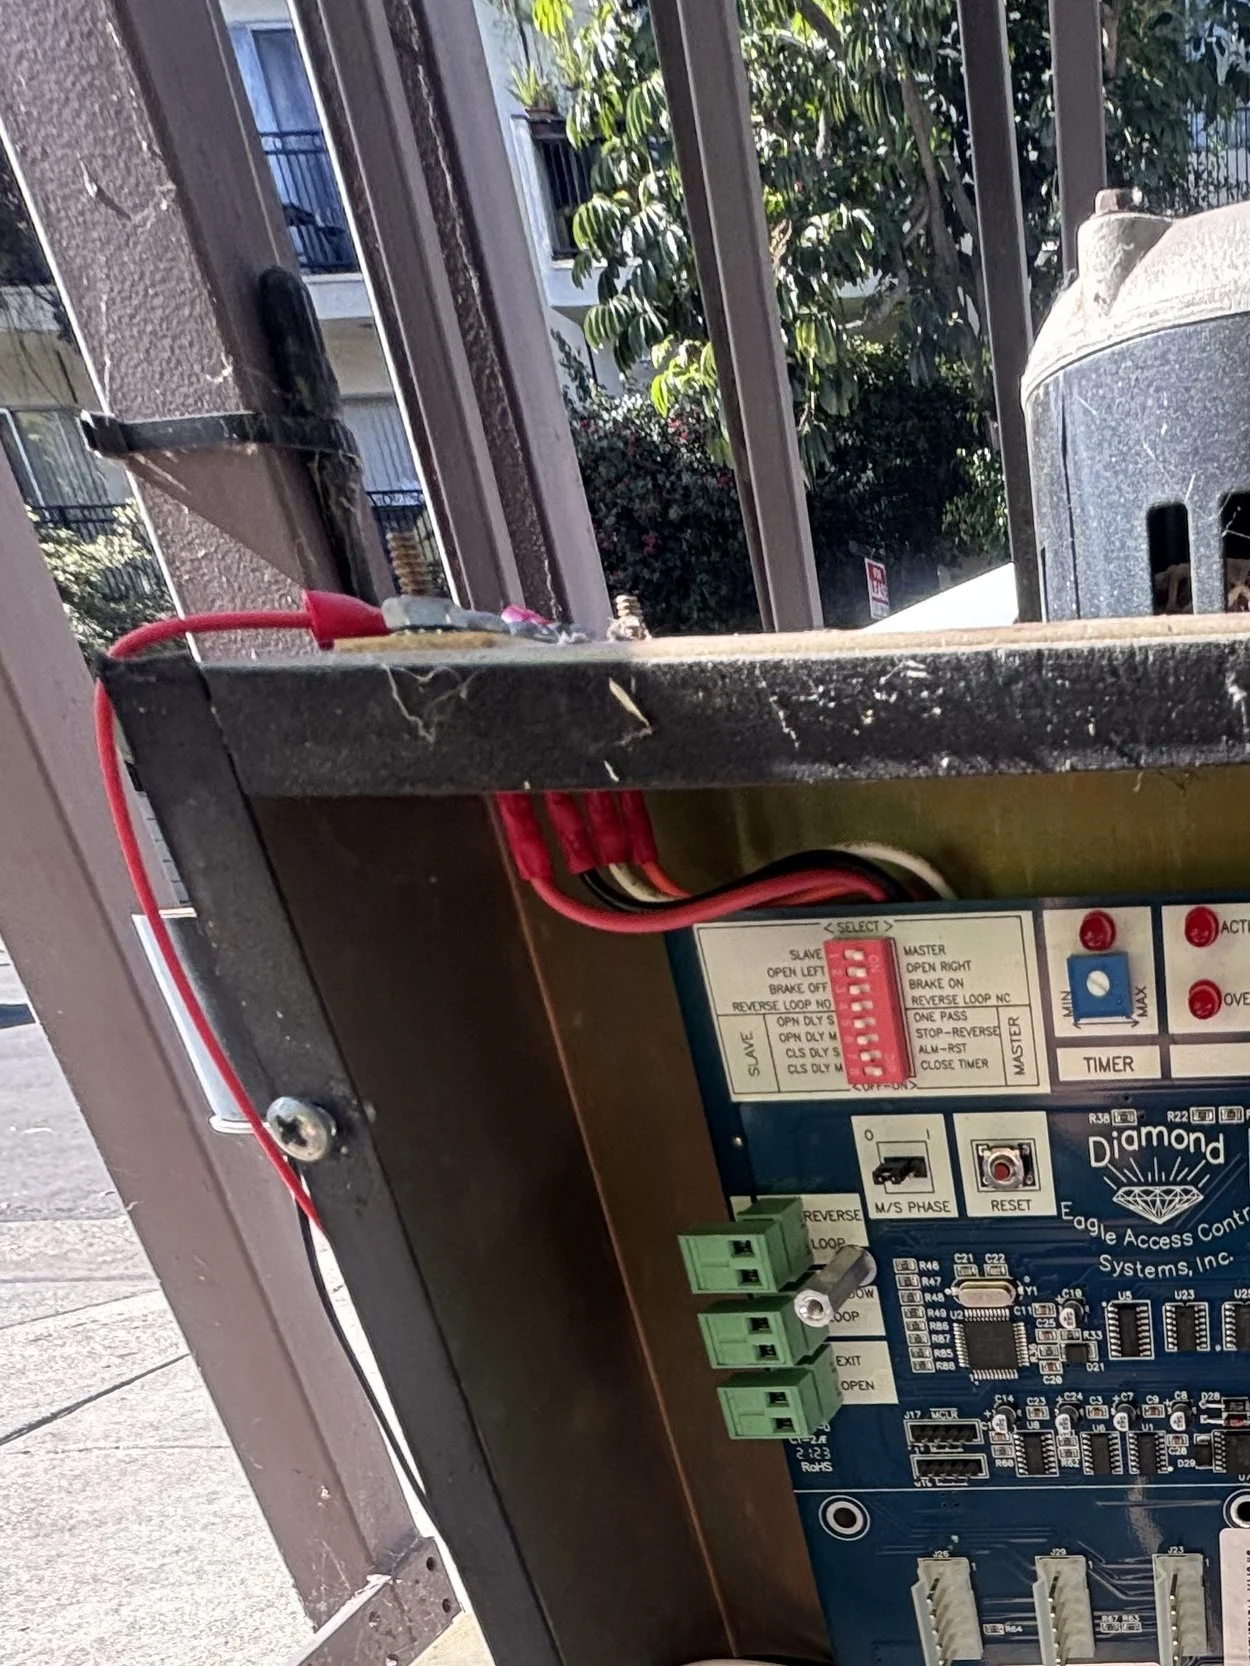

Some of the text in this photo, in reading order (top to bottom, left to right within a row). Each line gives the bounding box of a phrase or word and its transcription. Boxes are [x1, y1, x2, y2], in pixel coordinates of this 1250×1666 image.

[789, 949, 823, 960] SLAVE
[903, 945, 945, 956] MASTER
[767, 966, 825, 978] OPEN LEFT
[906, 960, 972, 973] OPEN RIGHT
[769, 982, 828, 994] BRAKE OFF
[909, 978, 964, 989] BRAKE ON
[732, 999, 832, 1012] REVERSE LOOP NO
[911, 993, 1011, 1006] REVERSE LOOP NC
[1062, 991, 1072, 1017] MIN
[1136, 987, 1147, 1016] MAX
[777, 1015, 835, 1026] OPN DLY S
[914, 1011, 968, 1022] ONE PASS
[779, 1032, 801, 1042] OPN
[805, 1032, 827, 1042] DLY
[915, 1026, 1000, 1038] STOP-REVERSE
[918, 1043, 967, 1054] ALM-RST
[1008, 1016, 1025, 1076] MASTER
[741, 1032, 760, 1077] SLAVE
[786, 1047, 840, 1059] CLS DLY S
[787, 1064, 808, 1074] CLS
[811, 1063, 833, 1073] DLY
[920, 1058, 989, 1071] CLOSE TIMER
[1083, 1056, 1135, 1073] TIMER
[1167, 1111, 1188, 1122] R22
[1089, 1125, 1224, 1168] Diamond
[876, 1201, 951, 1214] M/S PHASE
[991, 1199, 1032, 1212] RESET
[803, 1210, 862, 1222] REVERSE
[1061, 1202, 1117, 1245] Eagle
[1124, 1230, 1193, 1249] Access
[811, 1238, 845, 1250] LOOP
[1099, 1251, 1234, 1278] Systems, Inc.
[922, 1277, 941, 1287] R47
[1175, 1290, 1194, 1299] U23
[830, 1312, 859, 1323] OOP
[927, 1308, 947, 1318] R49
[836, 1356, 861, 1366] EXIT
[841, 1381, 874, 1390] OPEN
[995, 1395, 1014, 1403] C14
[1027, 1397, 1046, 1405] C23
[1121, 1393, 1133, 1401] C7
[801, 1462, 832, 1472] RoHS
